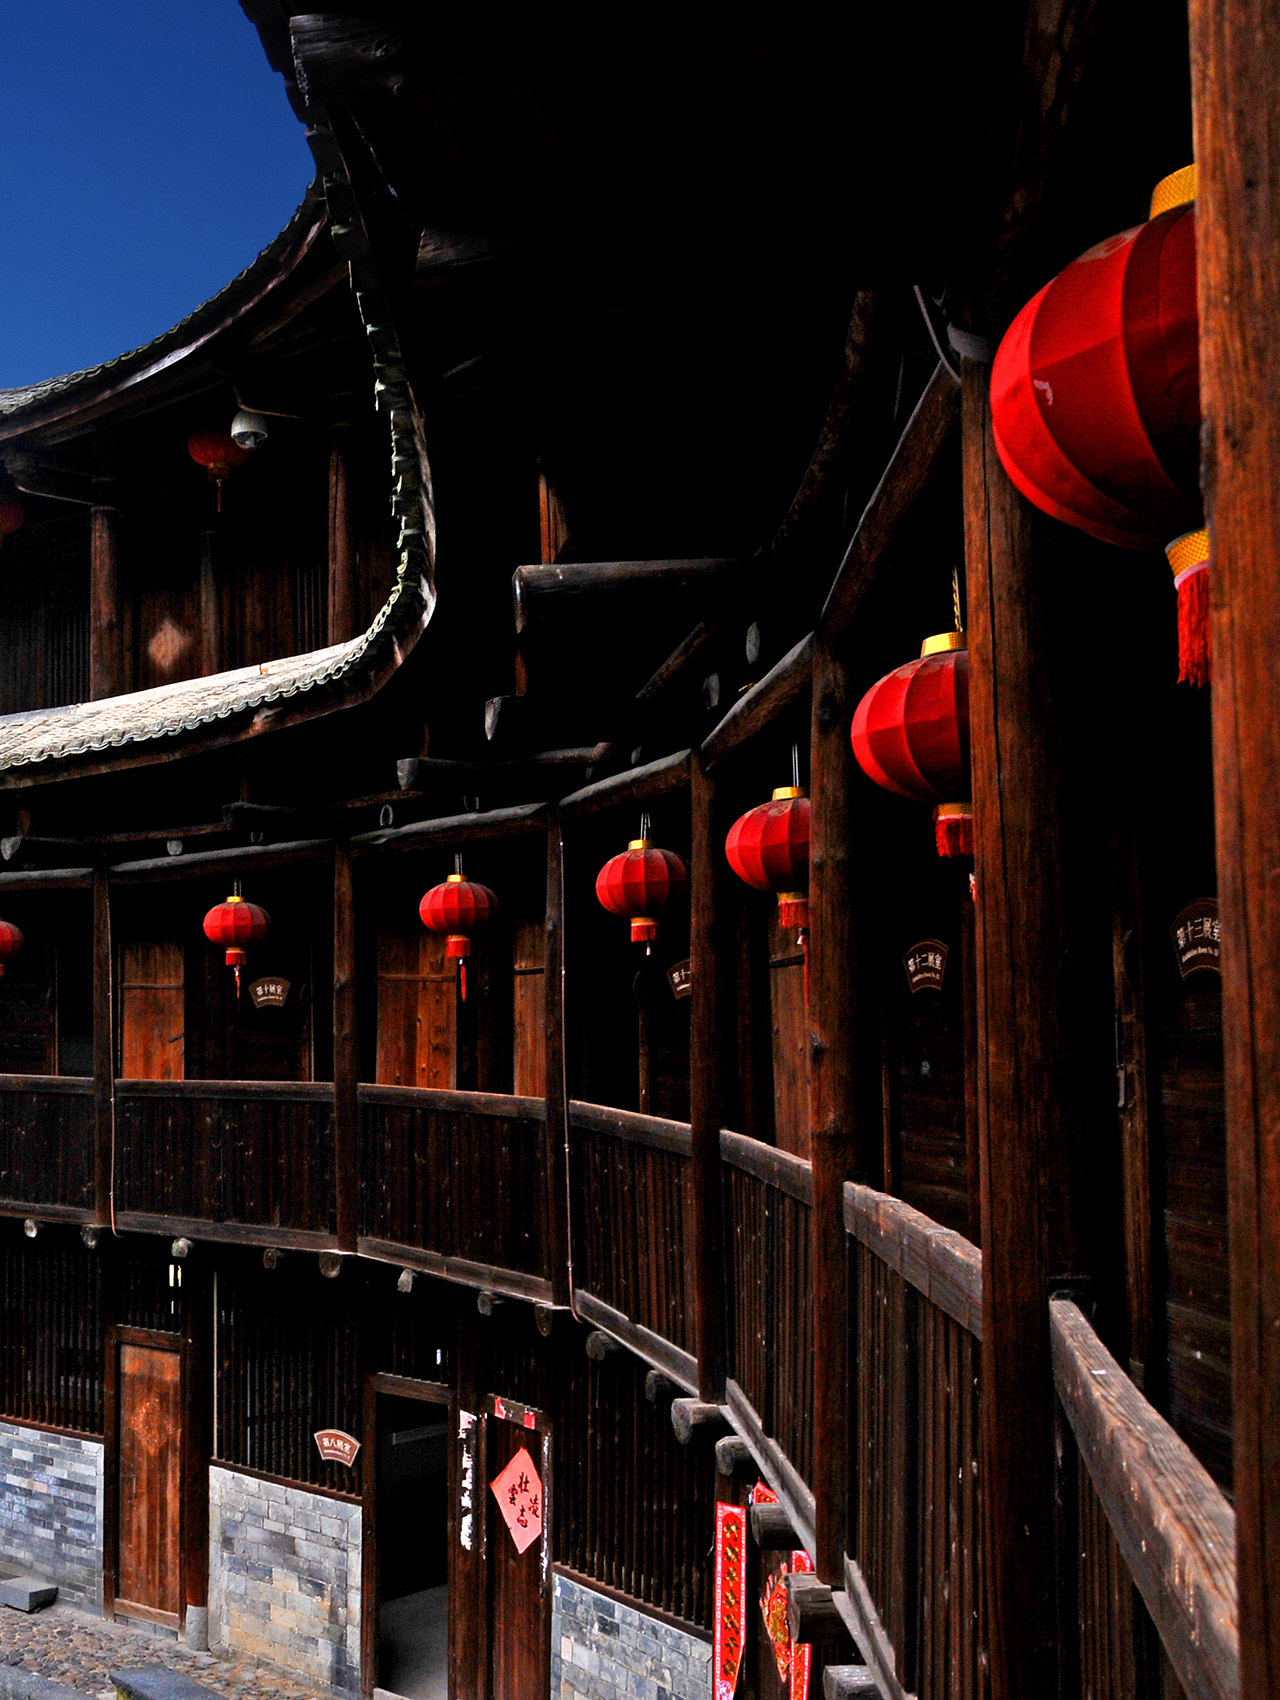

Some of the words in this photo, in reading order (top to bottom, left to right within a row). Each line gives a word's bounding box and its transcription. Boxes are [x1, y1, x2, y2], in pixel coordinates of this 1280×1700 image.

[1176, 917, 1220, 949] 第十三展室
[907, 952, 942, 974] 第十二展室
[255, 984, 283, 996] 第十展室
[322, 1437, 351, 1454] 第八展室
